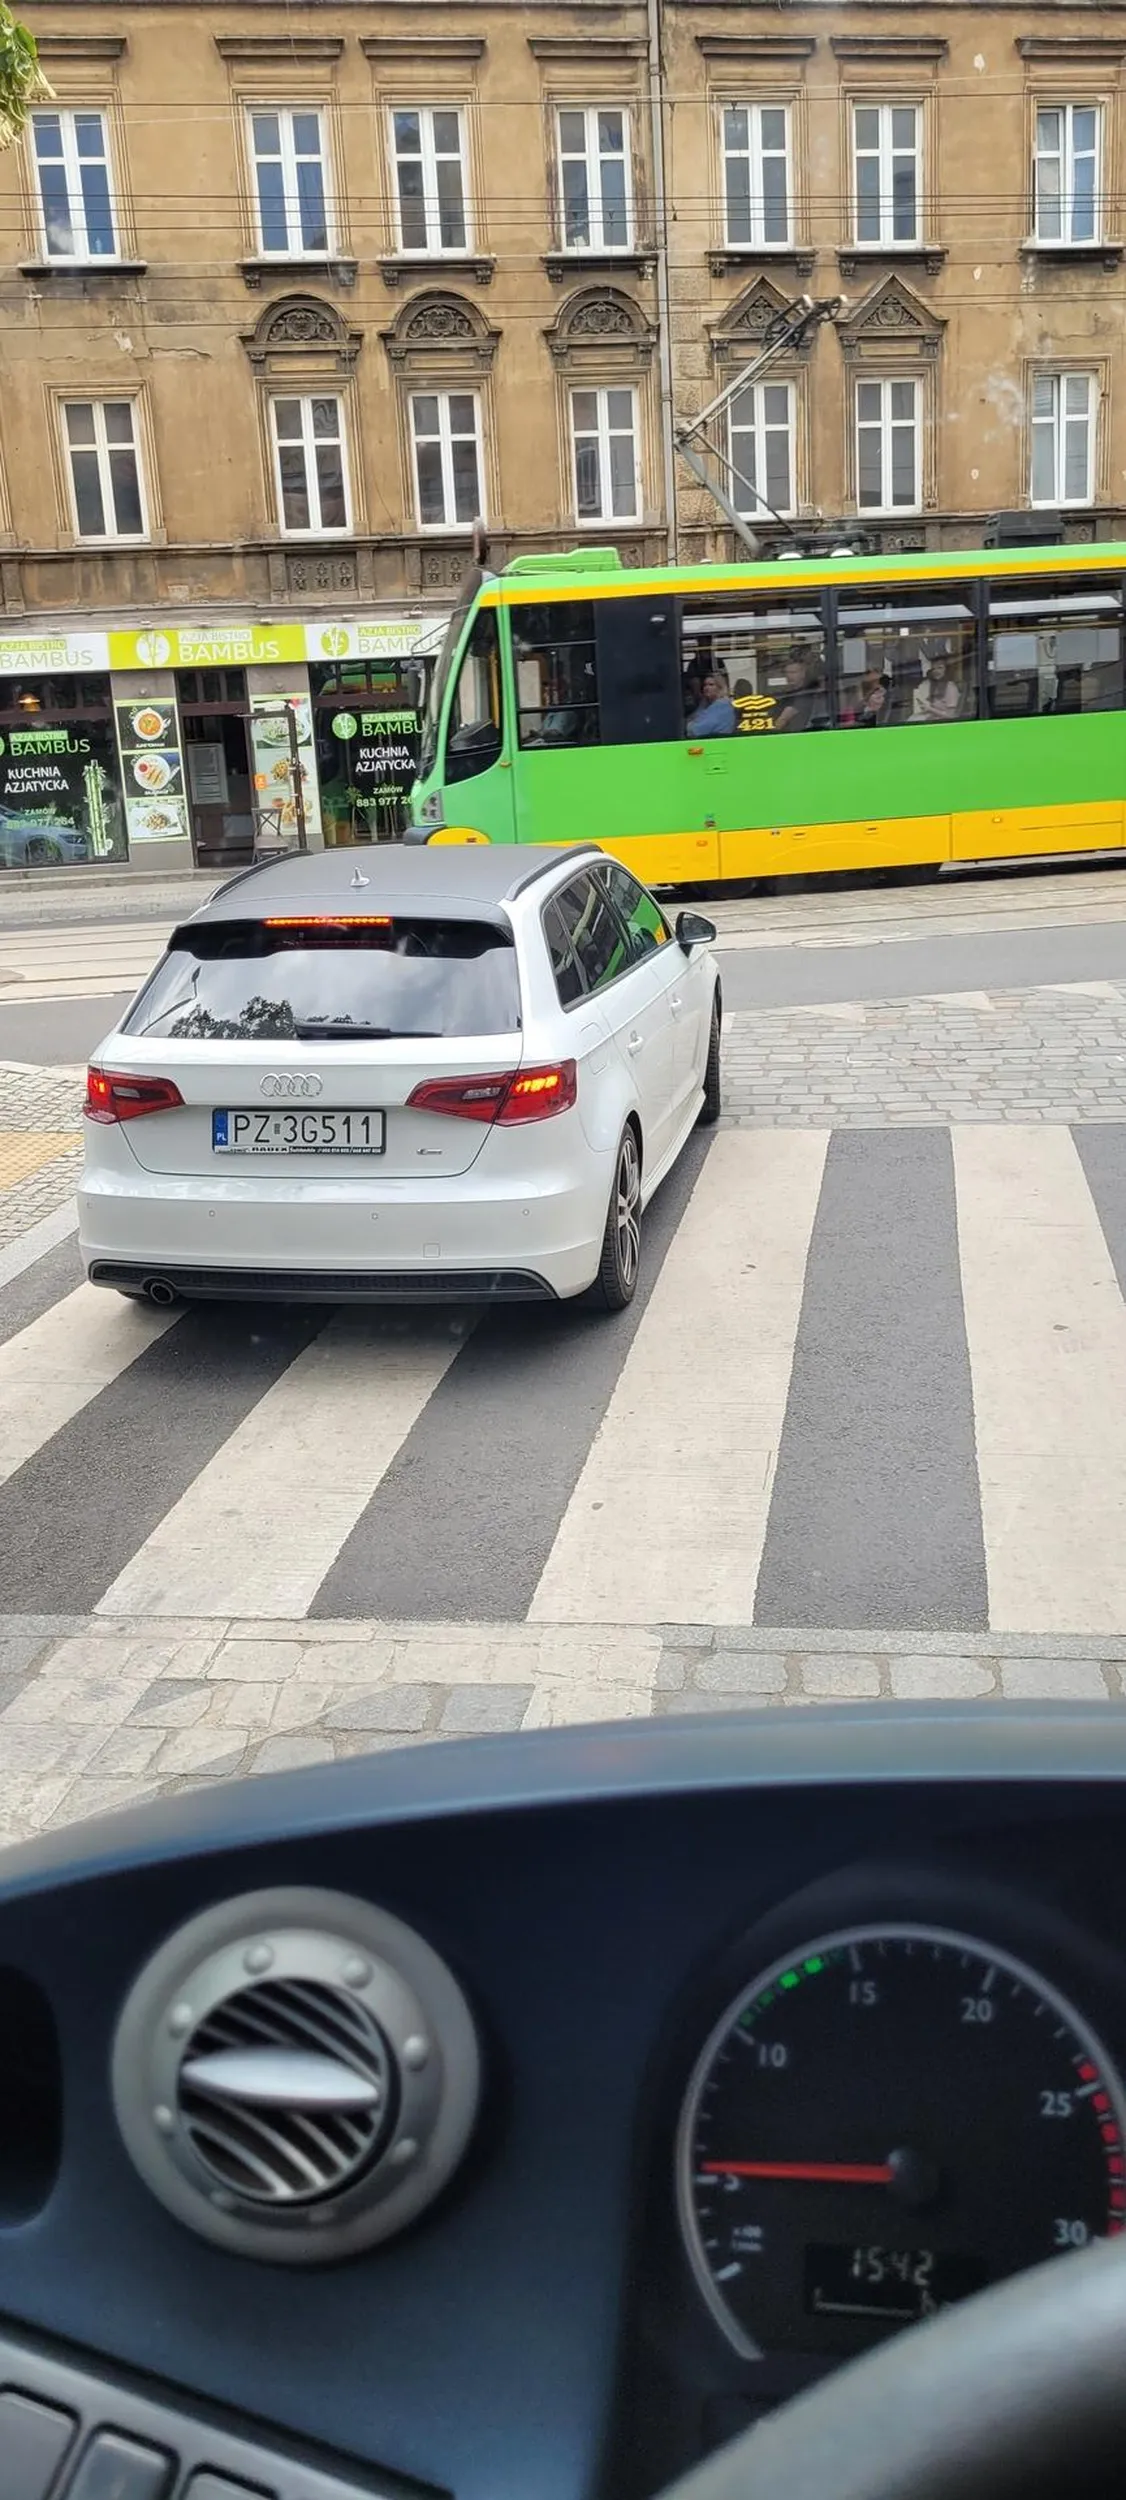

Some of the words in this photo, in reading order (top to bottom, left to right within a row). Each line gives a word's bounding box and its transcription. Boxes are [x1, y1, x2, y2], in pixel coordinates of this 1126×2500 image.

[180, 632, 210, 642] AZJA
[211, 631, 250, 641] BISTRO
[0, 649, 94, 669] BAMBUS
[179, 640, 280, 663] BAMBUS
[362, 720, 427, 737] BAMBU
[736, 717, 776, 731] 421
[11, 738, 91, 756] BAMBUS
[360, 746, 409, 759] KUCHNIA
[7, 766, 62, 779] KUCHNIA
[355, 759, 417, 772] AZJATYCKA
[4, 780, 70, 793] AZJATYCKA
[378, 796, 399, 805] 977
[216, 1132, 228, 1141] PL
[233, 1114, 271, 1144] PZ
[283, 1115, 371, 1145] 3G511
[849, 1980, 877, 2006] 15
[961, 1997, 993, 2023] 20
[759, 2042, 787, 2068] 10
[1040, 2090, 1073, 2118] 25
[1053, 2217, 1088, 2246] 30
